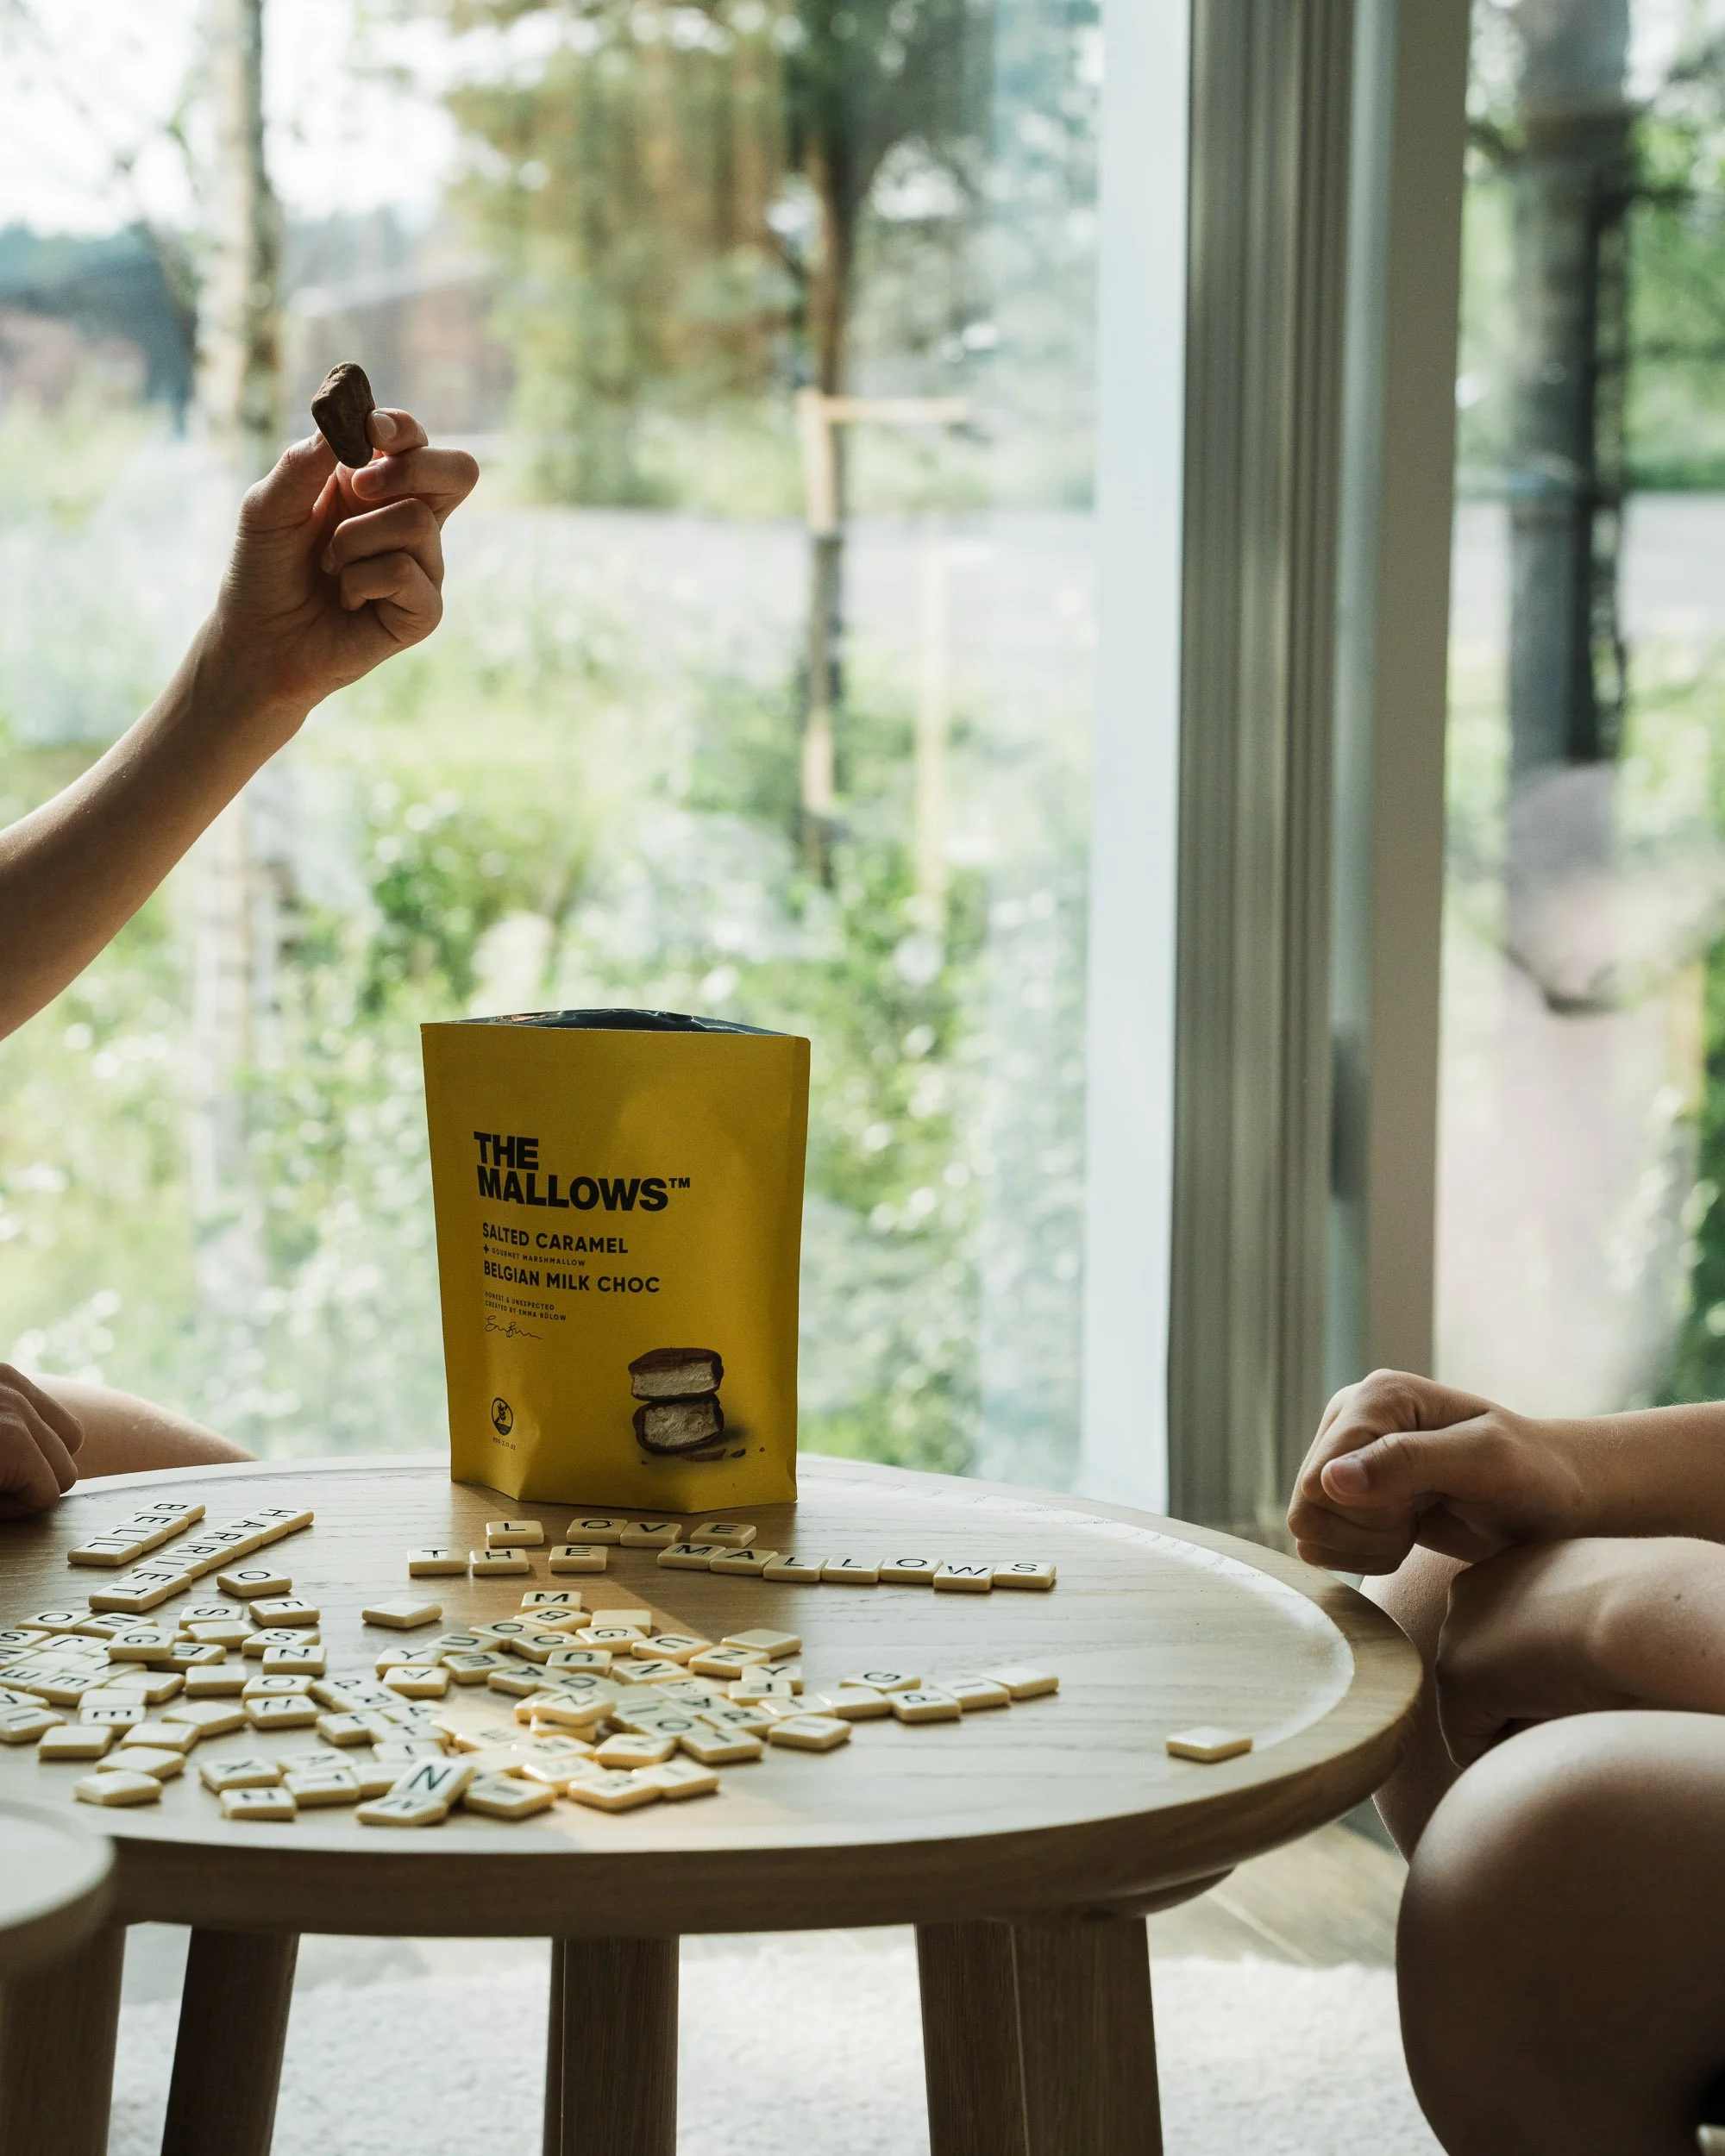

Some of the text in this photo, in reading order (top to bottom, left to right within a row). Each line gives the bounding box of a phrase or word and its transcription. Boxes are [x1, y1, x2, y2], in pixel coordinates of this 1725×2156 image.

[474, 1131, 539, 1170] THE
[482, 1222, 629, 1254] SALTED CARAMEL
[492, 1247, 519, 1260] GOURMET
[522, 1254, 586, 1266] MARSHMALLOW
[484, 1260, 660, 1293] BELGIAN MILK CHOC
[485, 1300, 507, 1312] CREATED
[518, 1308, 536, 1318] EMMA
[511, 1299, 555, 1311] UNEXPECTED
[86, 1503, 189, 1548] BELL
[111, 1508, 298, 1595] HARRIET
[672, 1544, 1039, 1577] MALLOWS
